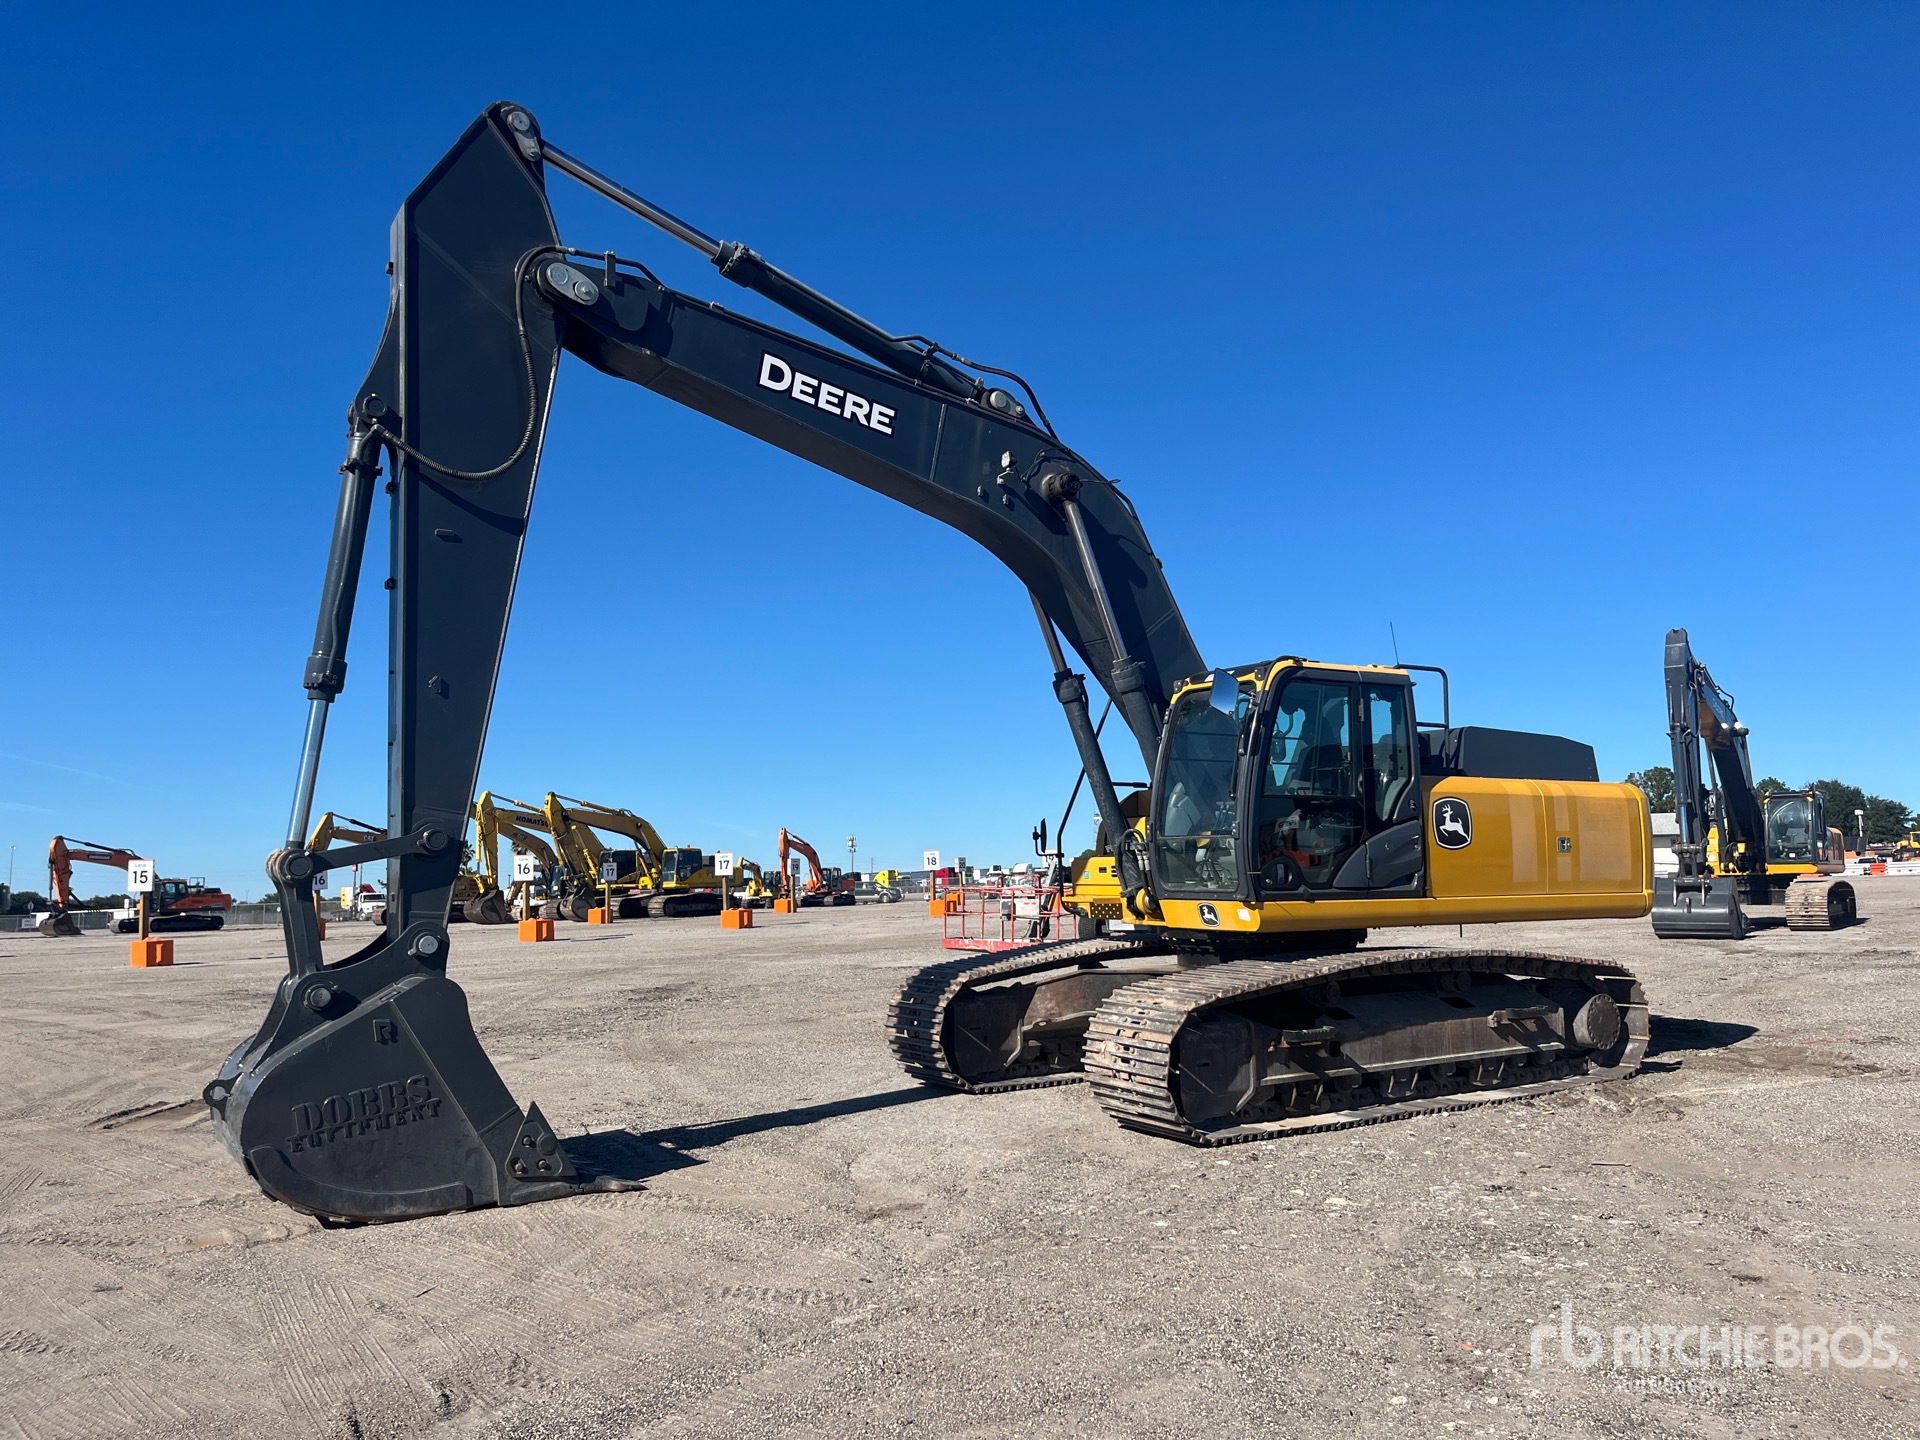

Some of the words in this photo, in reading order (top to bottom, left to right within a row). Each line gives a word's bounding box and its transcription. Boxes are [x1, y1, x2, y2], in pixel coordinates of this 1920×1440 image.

[759, 353, 896, 435] DEERE
[718, 860, 730, 870] 17
[926, 856, 937, 866] 18
[959, 861, 966, 869] 20
[517, 863, 531, 875] 16
[792, 863, 800, 871] 19
[132, 870, 148, 884] 15
[606, 868, 615, 877] 17
[313, 875, 326, 886] 16
[292, 1074, 432, 1133] DOBBS
